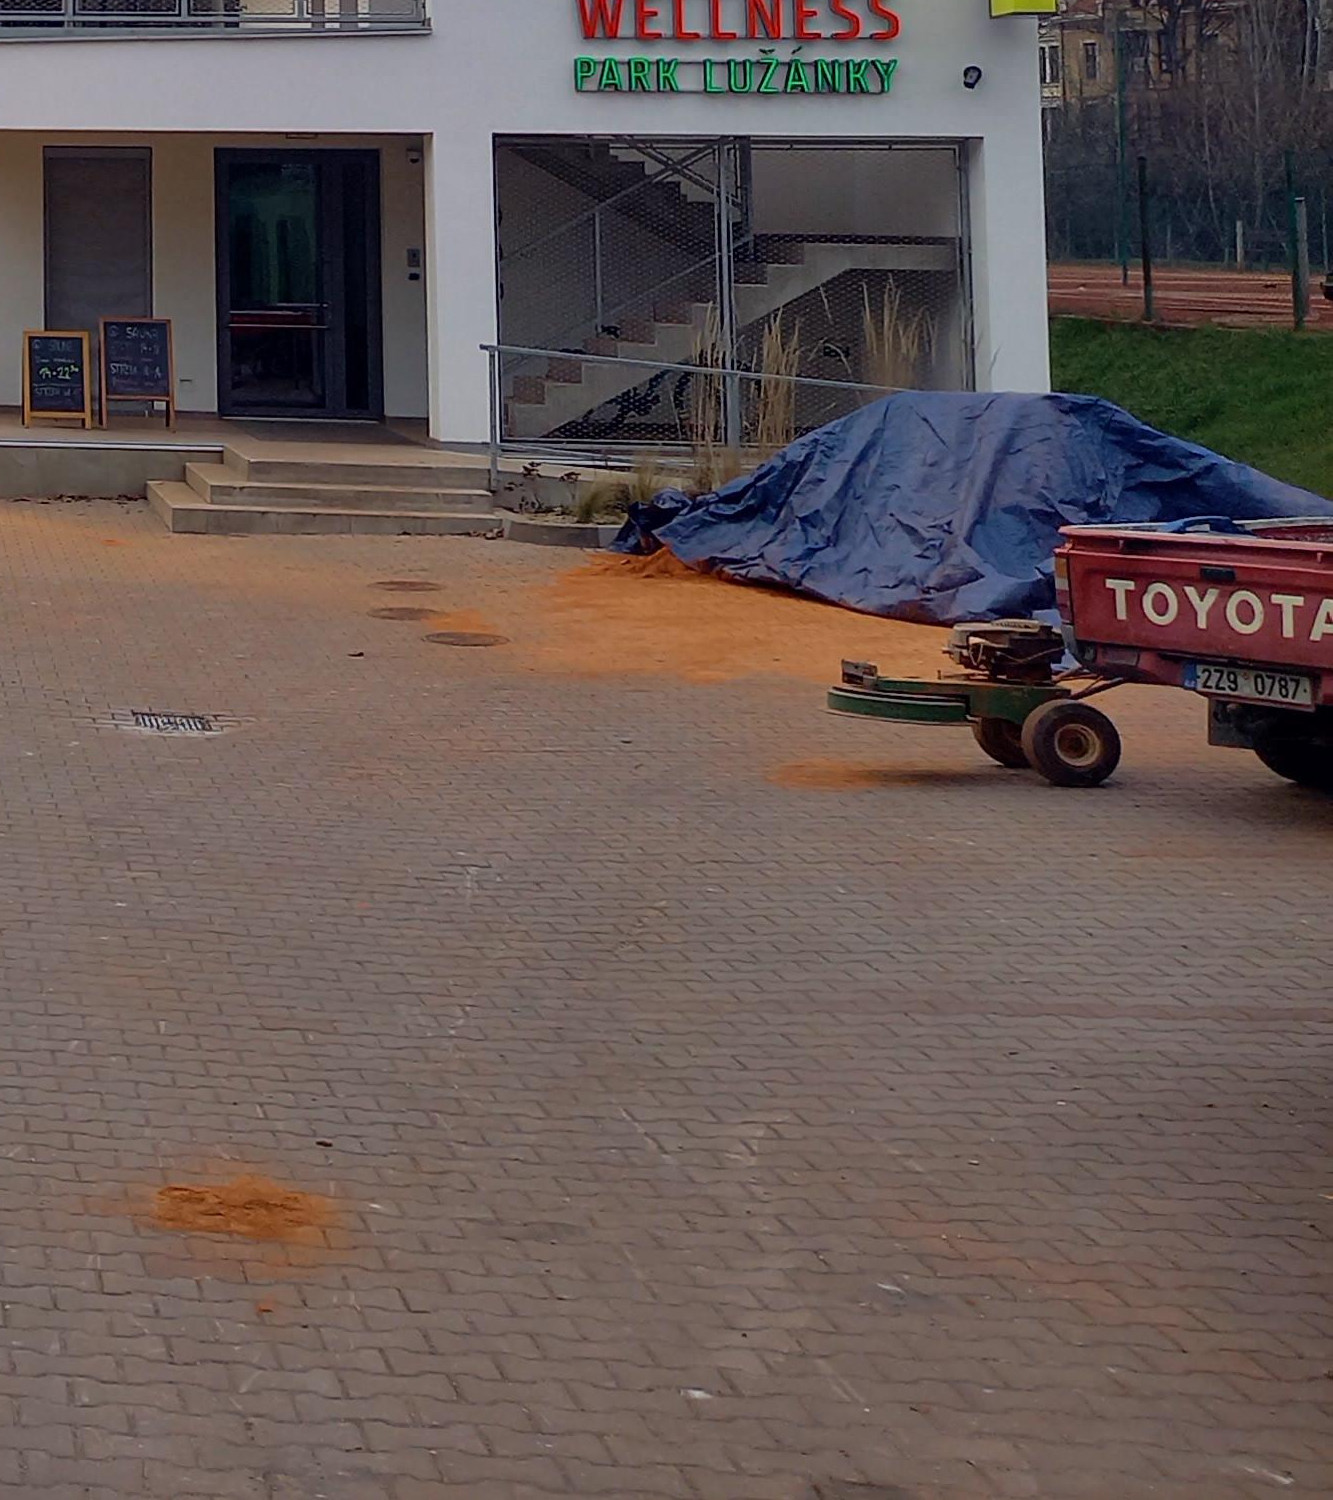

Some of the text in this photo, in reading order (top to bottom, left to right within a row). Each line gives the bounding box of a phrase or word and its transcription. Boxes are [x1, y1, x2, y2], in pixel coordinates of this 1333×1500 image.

[574, 45, 898, 94] PARK LUŽÁNKY
[1201, 668, 1301, 700] 2Z9 0787
